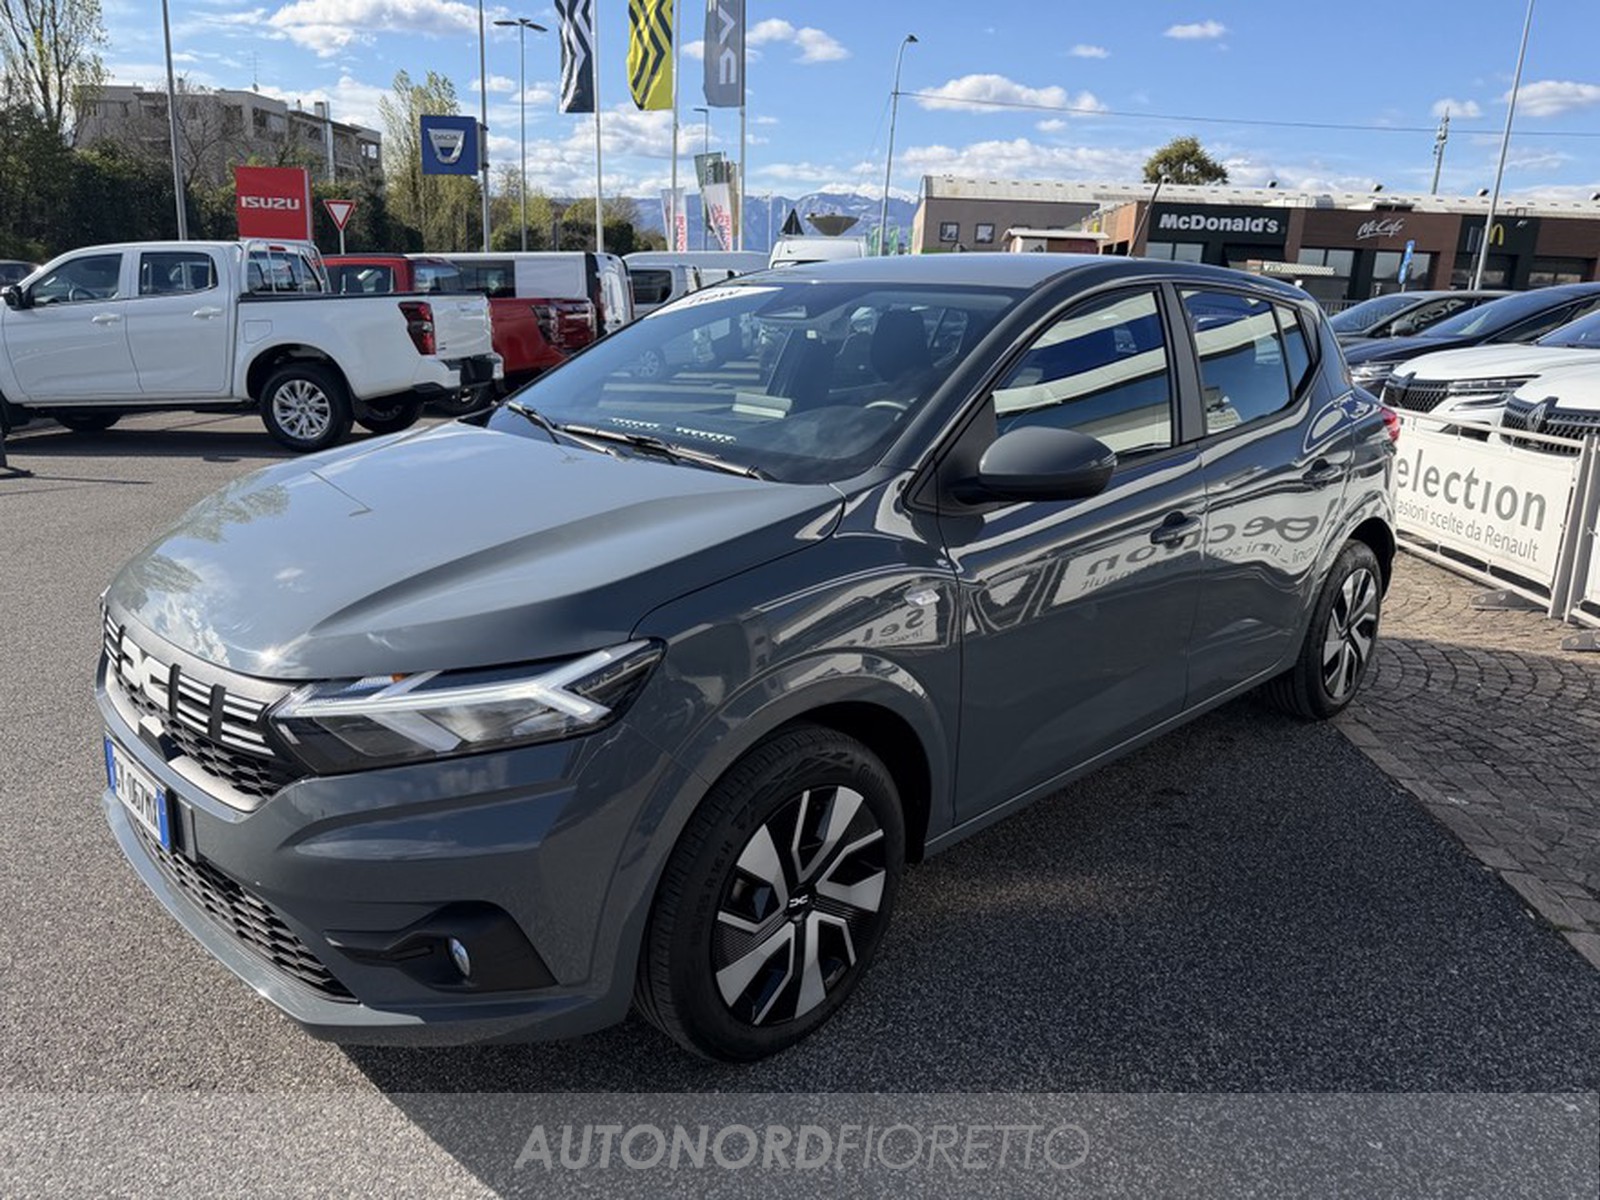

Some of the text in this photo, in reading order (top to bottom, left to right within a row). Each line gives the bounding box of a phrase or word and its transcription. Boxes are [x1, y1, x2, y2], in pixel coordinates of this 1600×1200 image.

[241, 195, 300, 210] ISUZU
[1158, 213, 1279, 234] McDonald's
[1397, 448, 1547, 532] election
[1397, 498, 1539, 562] asioni scelte da Renault
